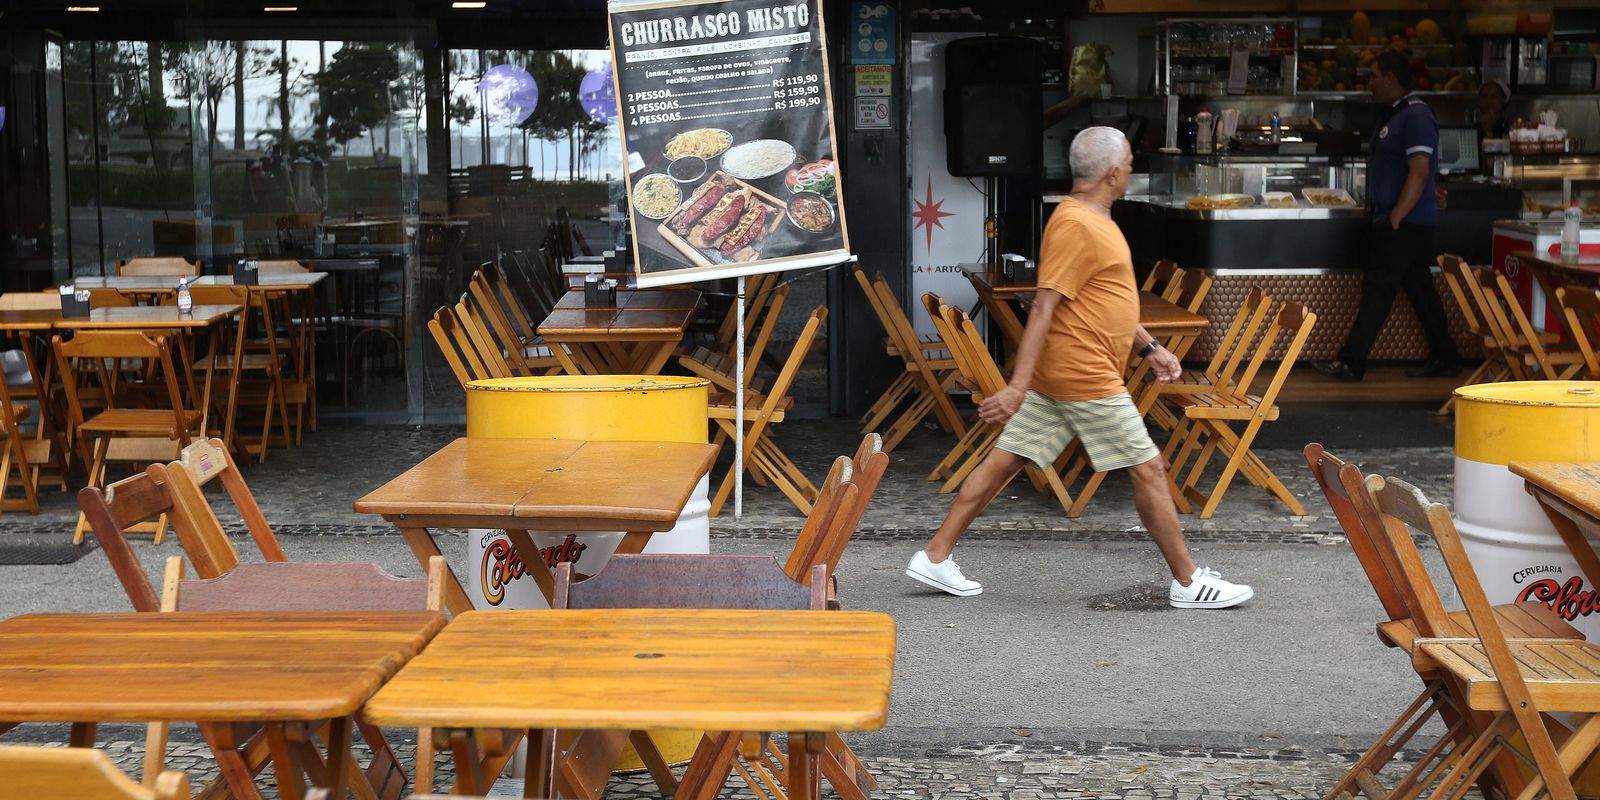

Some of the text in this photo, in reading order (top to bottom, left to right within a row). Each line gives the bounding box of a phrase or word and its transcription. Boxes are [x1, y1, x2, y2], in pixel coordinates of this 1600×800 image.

[621, 3, 809, 47] CHURRASCO MISTO
[627, 94, 634, 102] 2
[772, 78, 784, 88] R$
[786, 74, 818, 86] 119,90
[629, 106, 635, 114] 3
[774, 89, 785, 99] R$
[787, 85, 819, 98] 159,90
[631, 117, 638, 126] 4
[775, 101, 787, 110] R$
[788, 97, 820, 109] 199,90
[935, 265, 961, 273] ARTO
[481, 533, 587, 606] Coloado
[1513, 565, 1562, 584] CERVEJARIA
